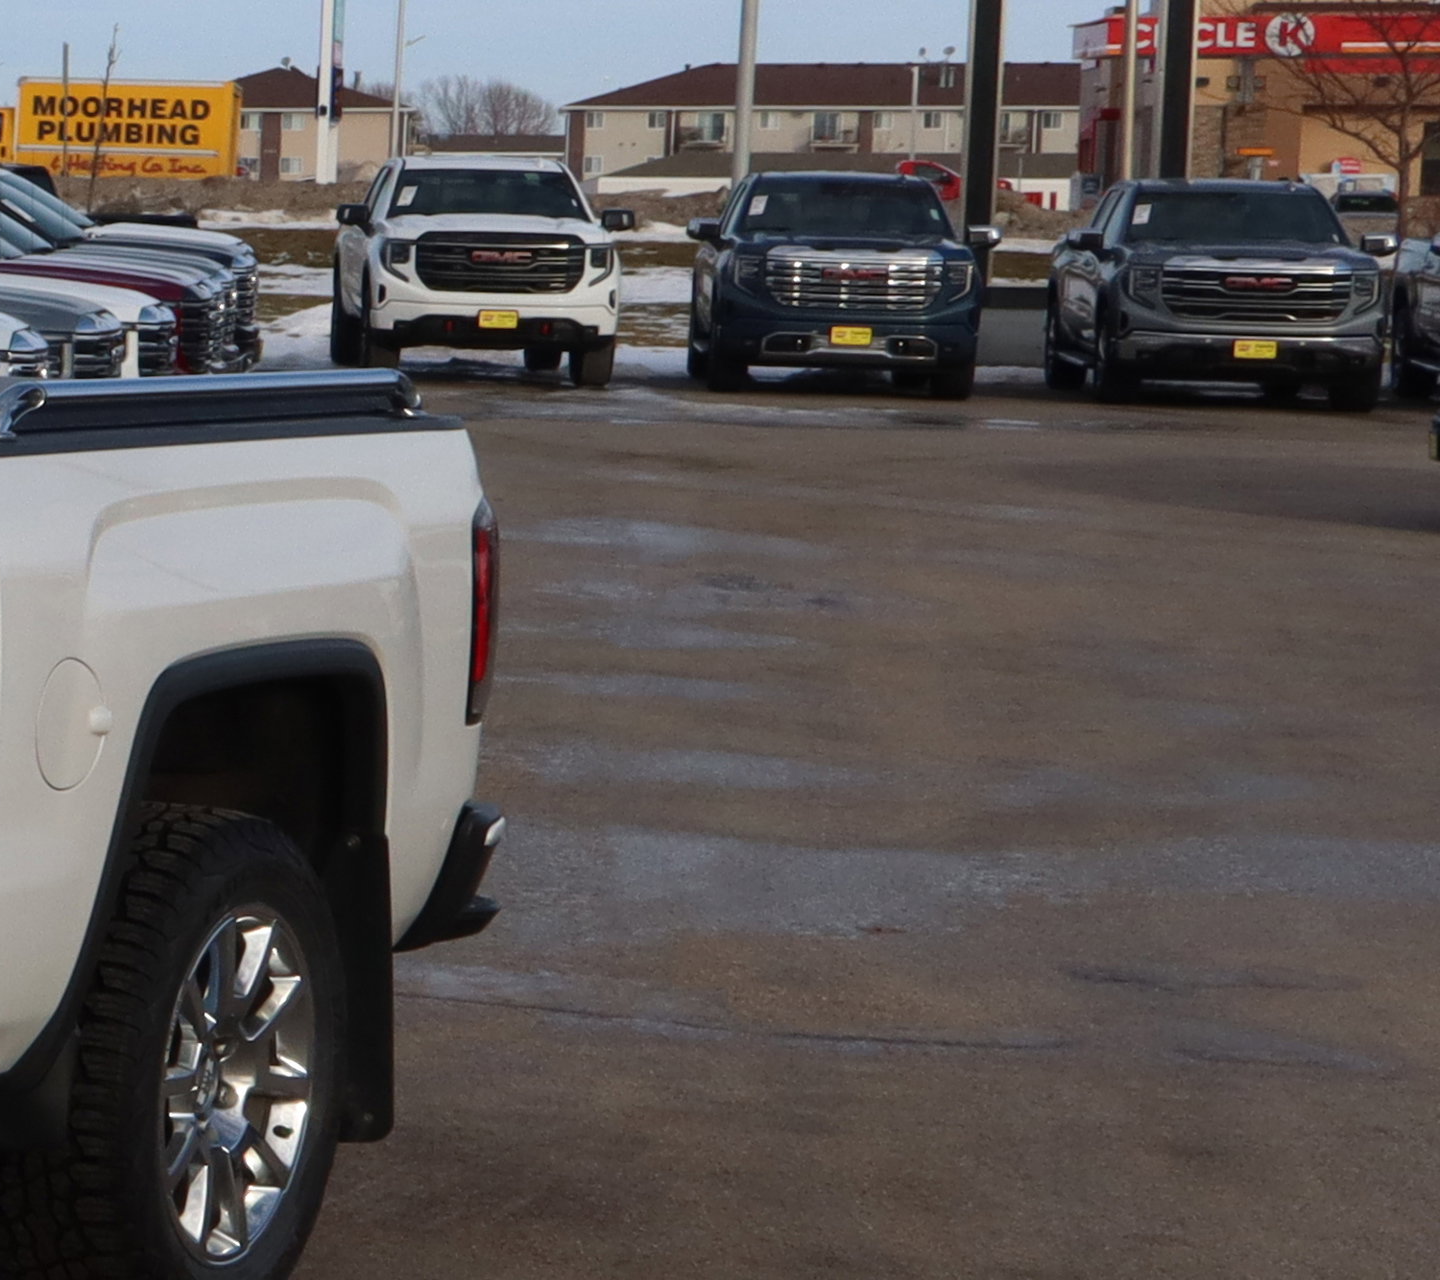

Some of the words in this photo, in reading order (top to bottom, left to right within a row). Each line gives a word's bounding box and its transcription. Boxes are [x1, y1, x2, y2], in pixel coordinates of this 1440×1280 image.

[1136, 22, 1256, 49] CICLE
[32, 95, 211, 121] MOORHEAD
[37, 120, 200, 146] PLUMBING
